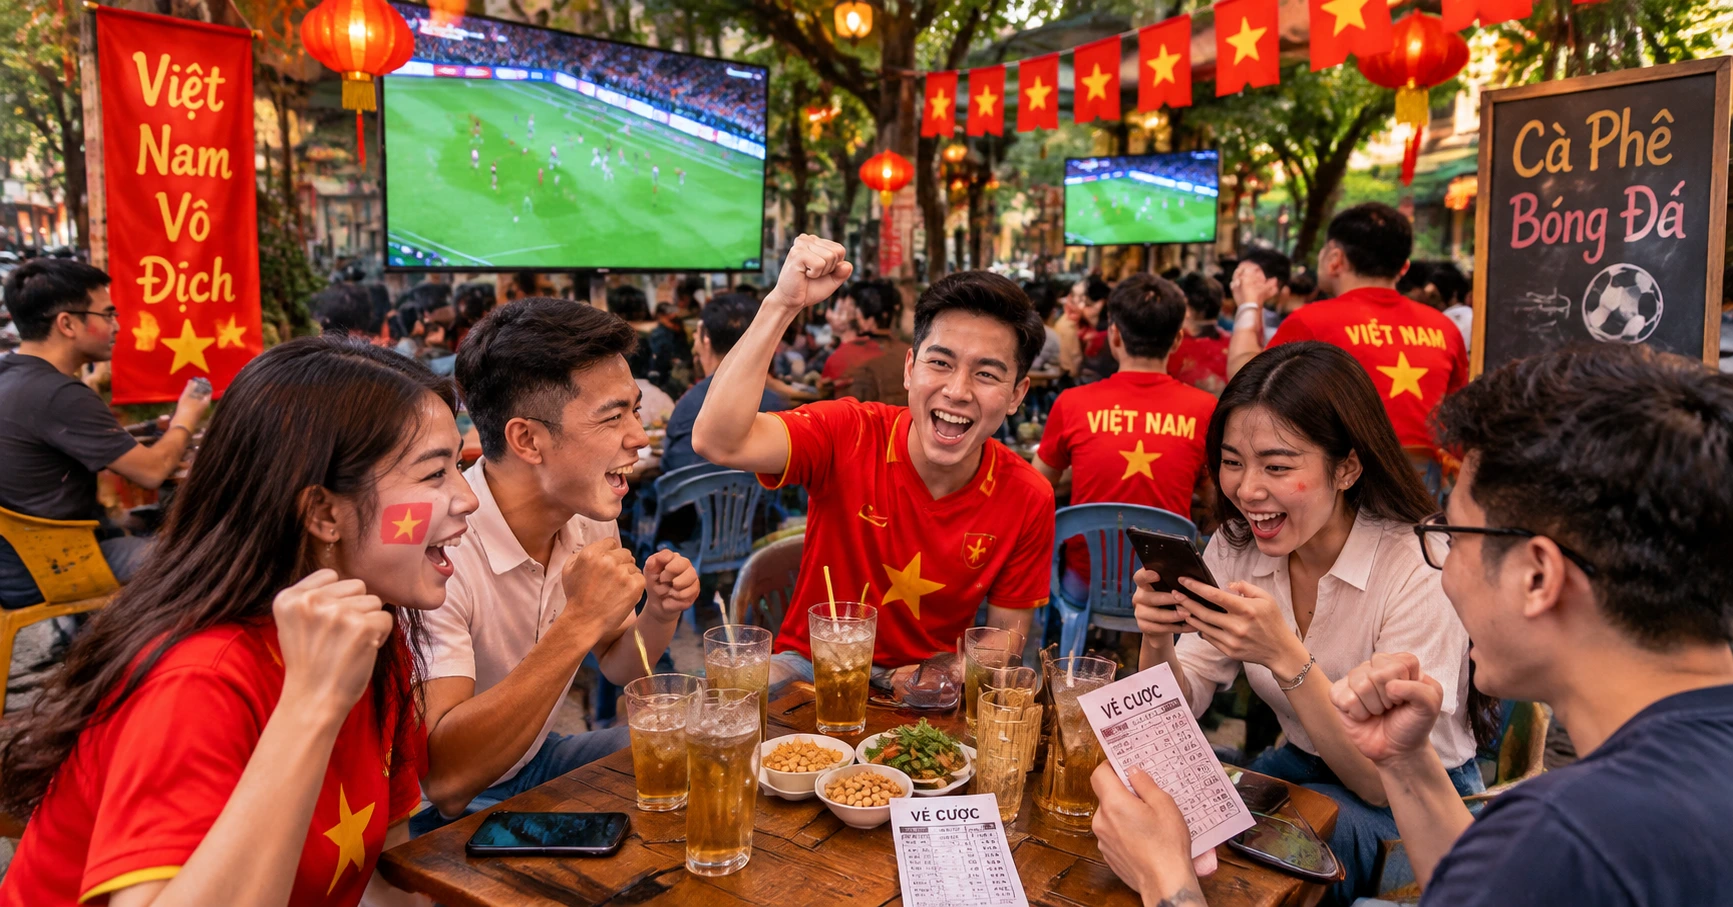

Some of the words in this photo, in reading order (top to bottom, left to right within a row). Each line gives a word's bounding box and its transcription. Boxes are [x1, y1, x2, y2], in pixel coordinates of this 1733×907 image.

[132, 51, 226, 120] Việt
[136, 123, 232, 180] Nam
[1512, 119, 1573, 178] Cà
[1585, 106, 1675, 171] Phê
[155, 192, 211, 243] Vô
[1509, 192, 1608, 264] Bóng
[1619, 180, 1686, 242] Đá
[135, 255, 236, 313] Địch
[1398, 325, 1447, 351] NAM
[1145, 412, 1197, 441] NAM
[1100, 697, 1122, 719] VÉ
[910, 807, 931, 822] VÉ
